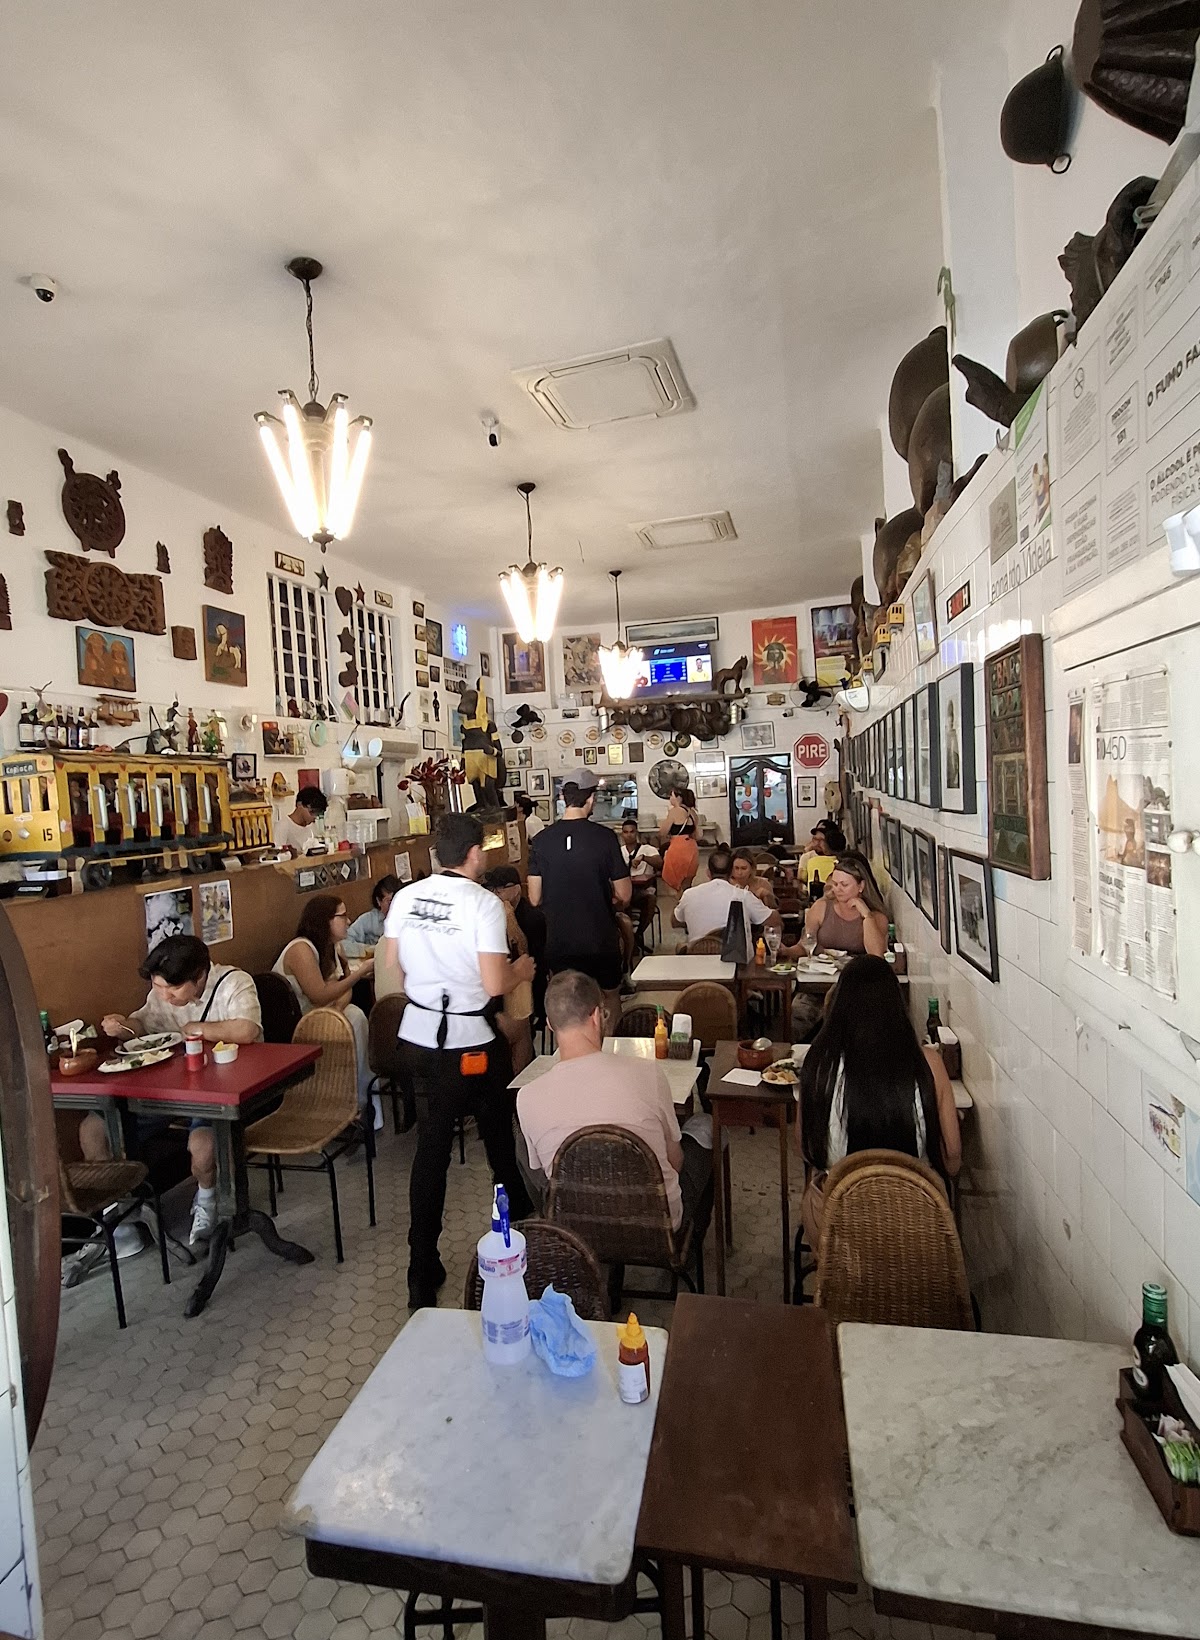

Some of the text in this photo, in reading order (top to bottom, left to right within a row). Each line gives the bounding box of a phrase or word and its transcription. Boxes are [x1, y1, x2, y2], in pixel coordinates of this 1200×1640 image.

[1147, 339, 1200, 407] O FUMO FA
[1023, 534, 1052, 579] Videla
[797, 743, 827, 759] PIRE
[43, 828, 53, 842] 15
